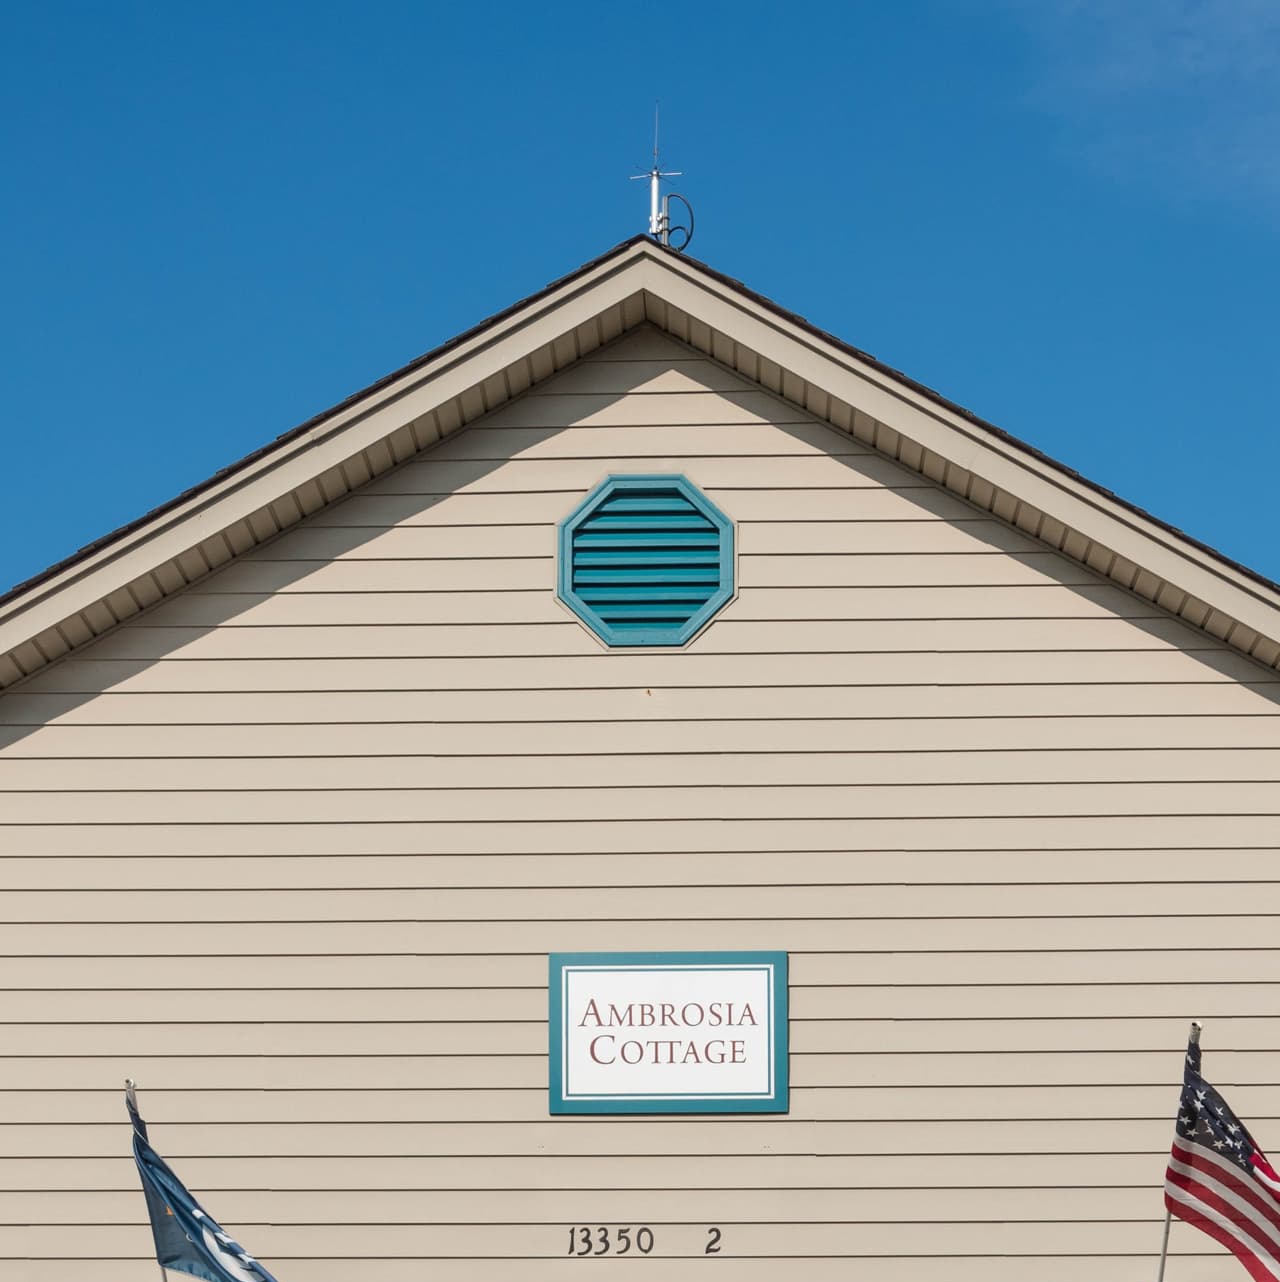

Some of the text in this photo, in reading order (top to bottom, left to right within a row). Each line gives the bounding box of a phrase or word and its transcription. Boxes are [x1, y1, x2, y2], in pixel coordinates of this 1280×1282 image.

[578, 998, 759, 1027] AMBROSIA
[589, 1034, 748, 1065] COTTAGE
[568, 1226, 722, 1256] 13350 2
